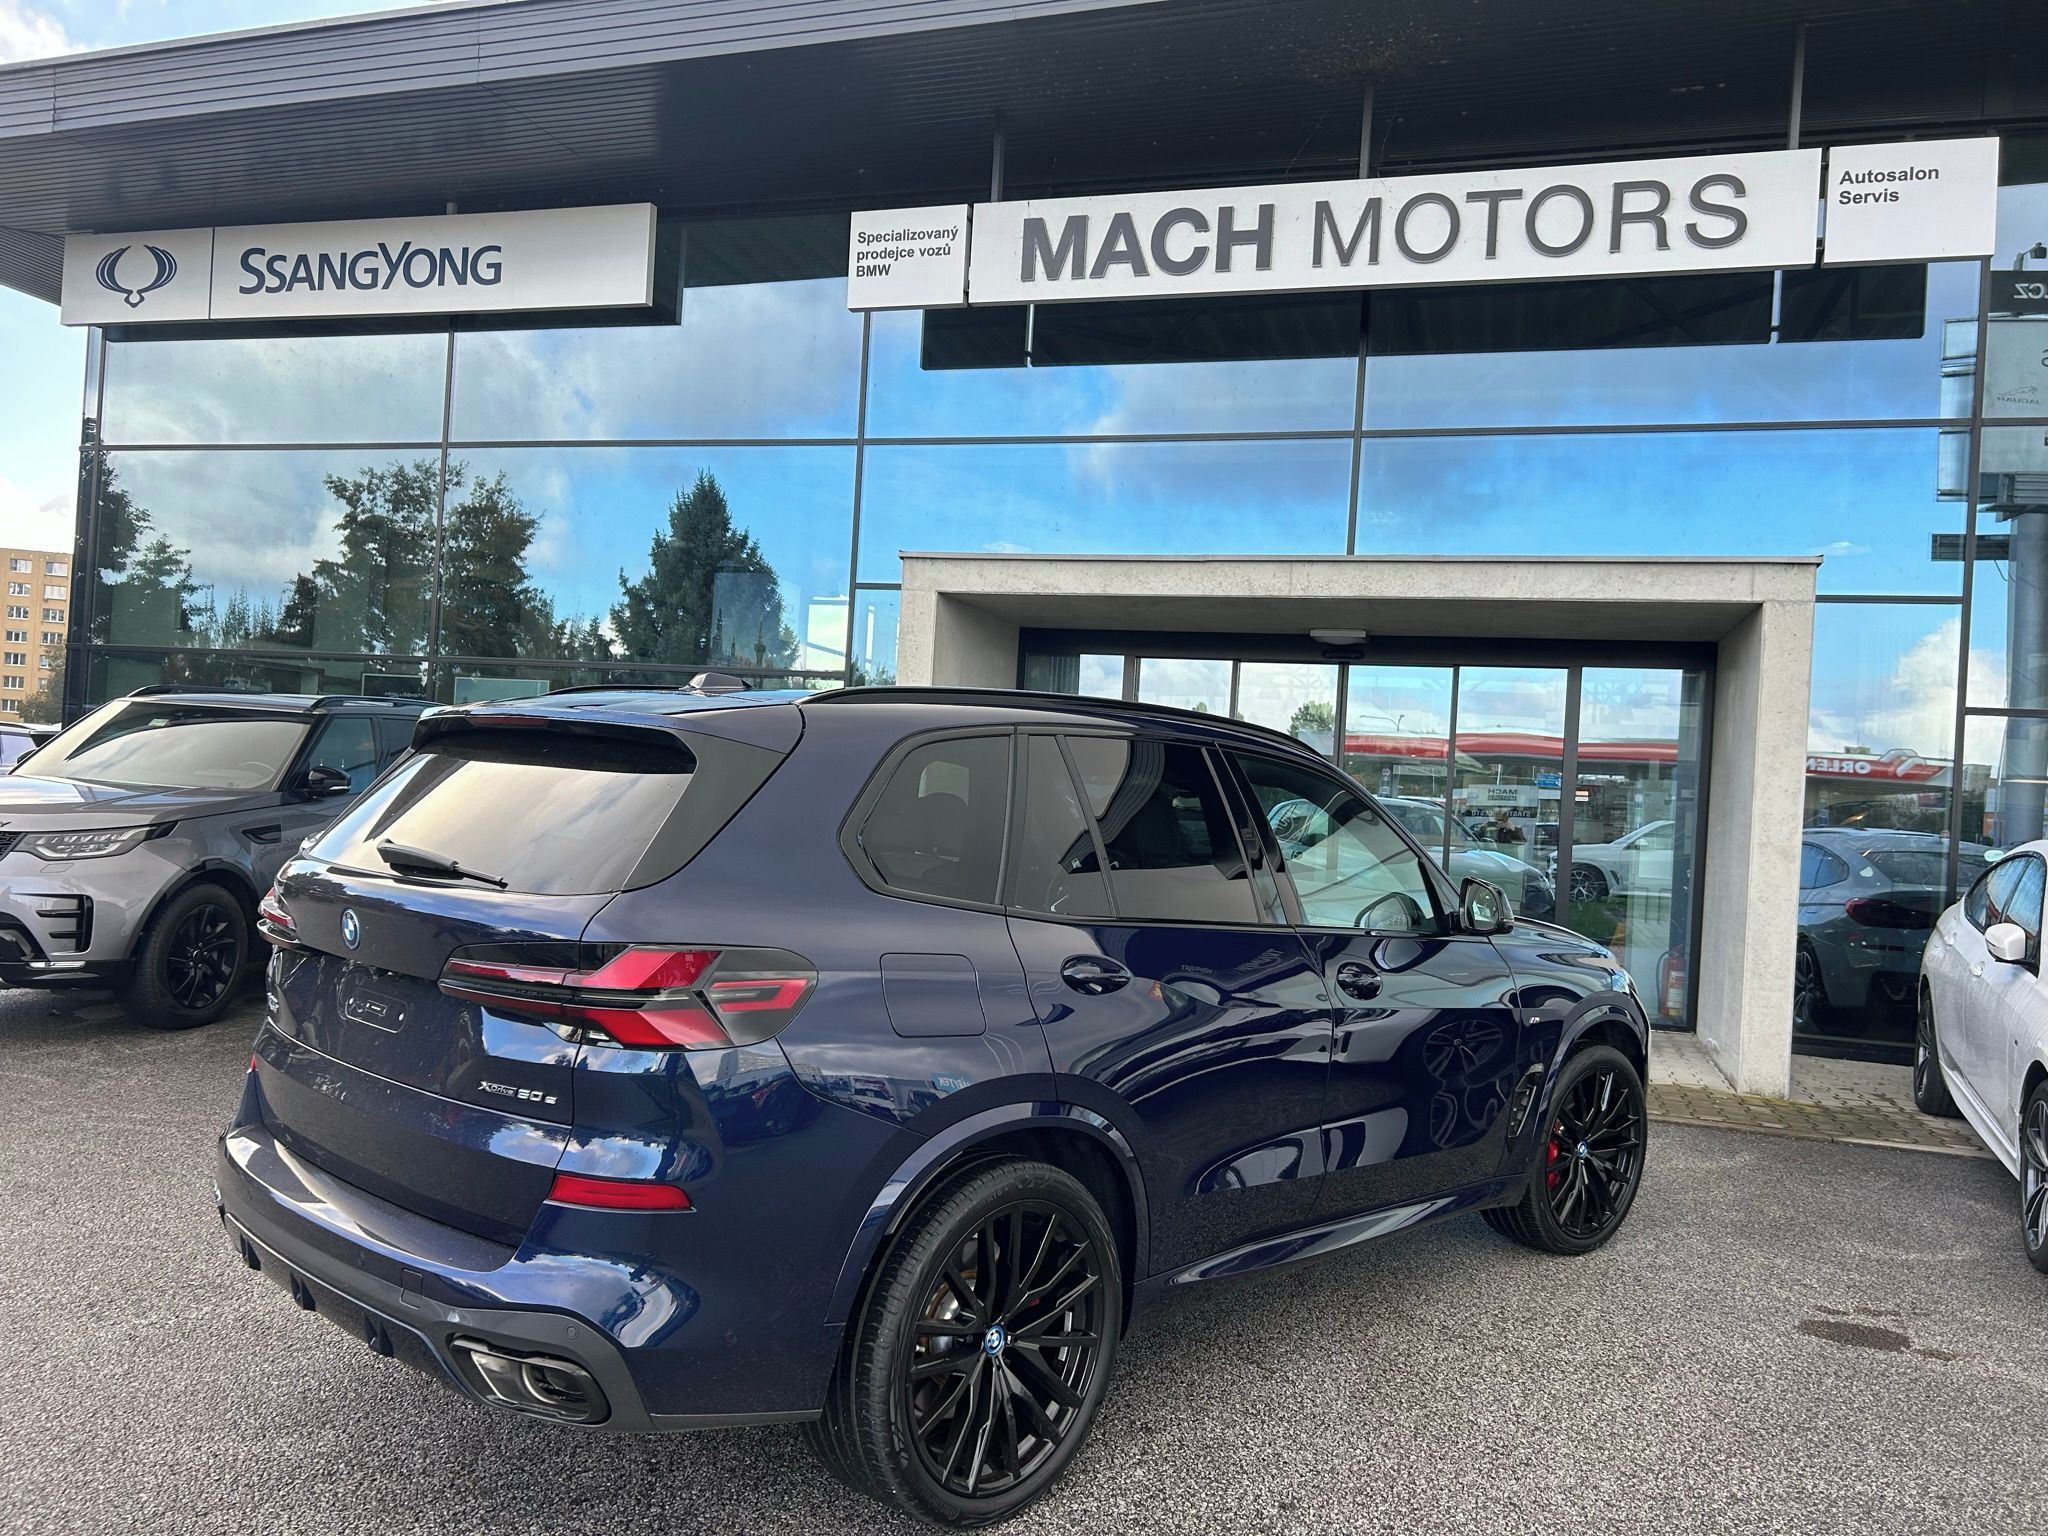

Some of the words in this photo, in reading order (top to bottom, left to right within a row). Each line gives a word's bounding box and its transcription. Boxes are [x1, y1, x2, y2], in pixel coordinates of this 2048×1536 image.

[1839, 166, 1940, 185] Autosalon
[1838, 188, 1900, 205] Servis
[857, 226, 959, 246] Specializovaný
[1020, 202, 1276, 283] MACH
[1311, 173, 1749, 268] MOTORS
[856, 246, 915, 264] prodejce
[918, 243, 951, 257] vozů
[856, 264, 892, 278] BMW
